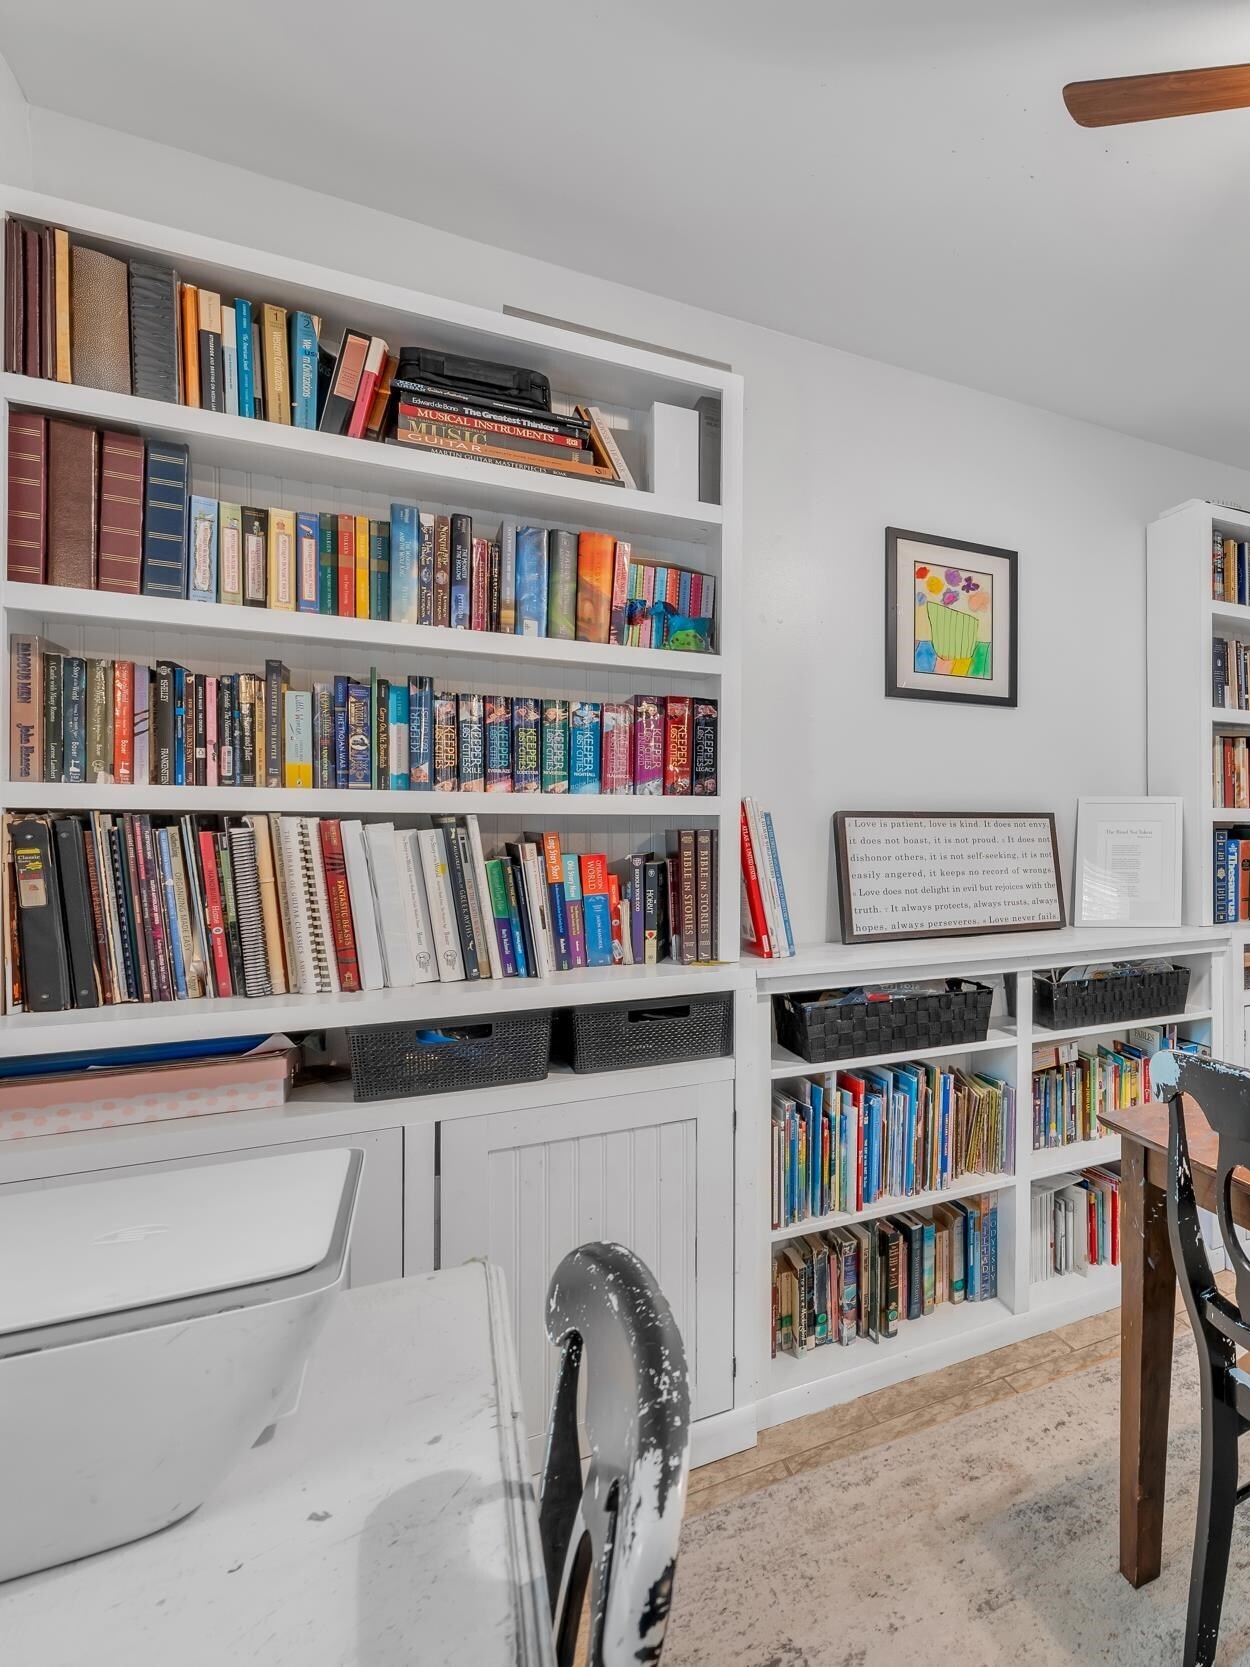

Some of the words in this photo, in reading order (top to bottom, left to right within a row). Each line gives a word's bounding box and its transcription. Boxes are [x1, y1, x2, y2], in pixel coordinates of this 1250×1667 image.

[273, 332, 283, 357] Western
[274, 357, 285, 392] Civilizations
[412, 397, 434, 408] Edward
[443, 403, 459, 412] Bono
[416, 409, 471, 427] MUSICAL
[474, 420, 555, 443] INSTRUMENTS
[463, 407, 481, 418] The
[482, 410, 520, 426] Greatest
[520, 417, 560, 432] Thinkers
[407, 433, 483, 453] GUITAR
[409, 420, 488, 446] MUSIC
[431, 447, 464, 460] MARTIN
[465, 453, 494, 464] GUITAR
[495, 458, 549, 474] MASTERPIECES
[72, 667, 80, 678] Story
[72, 687, 80, 701] World
[462, 723, 470, 744] LOST
[471, 724, 482, 766] KEEPER
[546, 728, 554, 748] LOST
[576, 730, 584, 749] LOST
[670, 724, 678, 744] LOST
[677, 725, 687, 765] KEEPER
[72, 741, 80, 757] Bauer
[444, 725, 455, 769] KEEPER
[462, 744, 471, 767] CITIES
[498, 726, 508, 768] KEEPER
[526, 728, 536, 769] KEEPER
[553, 729, 564, 770] KEEPER
[583, 731, 593, 771] KEEPER
[652, 728, 662, 769] KEEPER
[670, 744, 678, 766] CITIES
[704, 726, 714, 765] KEEPER
[160, 748, 169, 785] FRANKENSTEIN
[546, 748, 554, 770] CITIES
[576, 749, 584, 772] CITIES
[855, 820, 876, 828] Love
[880, 819, 887, 828] is
[891, 820, 926, 831] patient,
[929, 820, 946, 828] love
[950, 820, 957, 828] is
[960, 820, 980, 828] kind.
[984, 819, 991, 828] It
[994, 819, 1010, 828] does
[1013, 820, 1027, 828] not
[547, 836, 556, 849] Long
[850, 837, 856, 845] it
[860, 836, 881, 845] does
[886, 836, 900, 845] not
[904, 836, 931, 846] boast,
[934, 836, 942, 845] it
[945, 835, 952, 844] is
[955, 836, 969, 844] not
[972, 835, 999, 847] proud.
[1007, 835, 1015, 844] It
[1018, 835, 1034, 843] does
[1038, 835, 1051, 843] not
[285, 847, 294, 878] LIBRARY
[549, 850, 559, 864] Story
[683, 851, 692, 878] BIBLE
[700, 850, 709, 878] BIBLE
[850, 853, 892, 862] dishonor
[895, 853, 927, 863] others,
[930, 852, 938, 861] it
[940, 852, 948, 861] is
[951, 852, 964, 860] not
[968, 850, 1018, 864] self-seeking,
[1021, 851, 1028, 859] it
[1031, 850, 1038, 859] is
[1040, 850, 1052, 859] not
[434, 863, 442, 877] World
[551, 866, 561, 880] Short
[567, 869, 576, 883] Story
[587, 861, 596, 890] WORLD
[852, 869, 881, 883] easily
[885, 868, 926, 882] angered,
[930, 868, 938, 878] it
[941, 867, 966, 880] keeps
[970, 868, 980, 877] no
[983, 866, 1009, 877] record
[1012, 866, 1021, 875] of
[1024, 866, 1056, 878] wrongs.
[174, 872, 187, 912] ORGANIZING
[289, 880, 296, 890] OF
[569, 885, 577, 898] New
[684, 882, 691, 891] IN
[700, 881, 708, 890] IN
[859, 887, 880, 897] Love
[883, 887, 901, 896] does
[905, 886, 918, 895] not
[921, 884, 950, 896] delight
[953, 884, 961, 893] in
[963, 883, 978, 893] evil
[980, 882, 993, 892] but
[996, 882, 1024, 894] rejoices
[1026, 882, 1043, 892] with
[1046, 881, 1057, 890] the
[1228, 853, 1238, 916] Thesaurus
[291, 892, 300, 918] GUITAR
[337, 880, 349, 918] FANTASTIC
[459, 889, 469, 913] GREEK
[646, 889, 654, 914] HOBBIT
[854, 905, 881, 914] truth.
[891, 903, 899, 912] It
[902, 901, 932, 914] always
[935, 900, 971, 912] protects,
[974, 899, 1001, 911] always
[1004, 898, 1029, 909] trusts,
[1032, 896, 1058, 908] always
[180, 914, 189, 933] MADE
[212, 905, 221, 924] Home
[684, 894, 694, 935] STORIES
[700, 893, 709, 934] STORIES
[855, 921, 887, 934] hopes,
[891, 919, 925, 932] always
[928, 917, 978, 931] perseveres.
[989, 914, 1010, 925] Love
[1013, 912, 1035, 923] never
[341, 919, 353, 946] BEASTS
[463, 914, 473, 938] MYTHS
[182, 934, 192, 952] EASY
[294, 921, 304, 955] CLASSICS
[1134, 1030, 1155, 1041] FABLES
